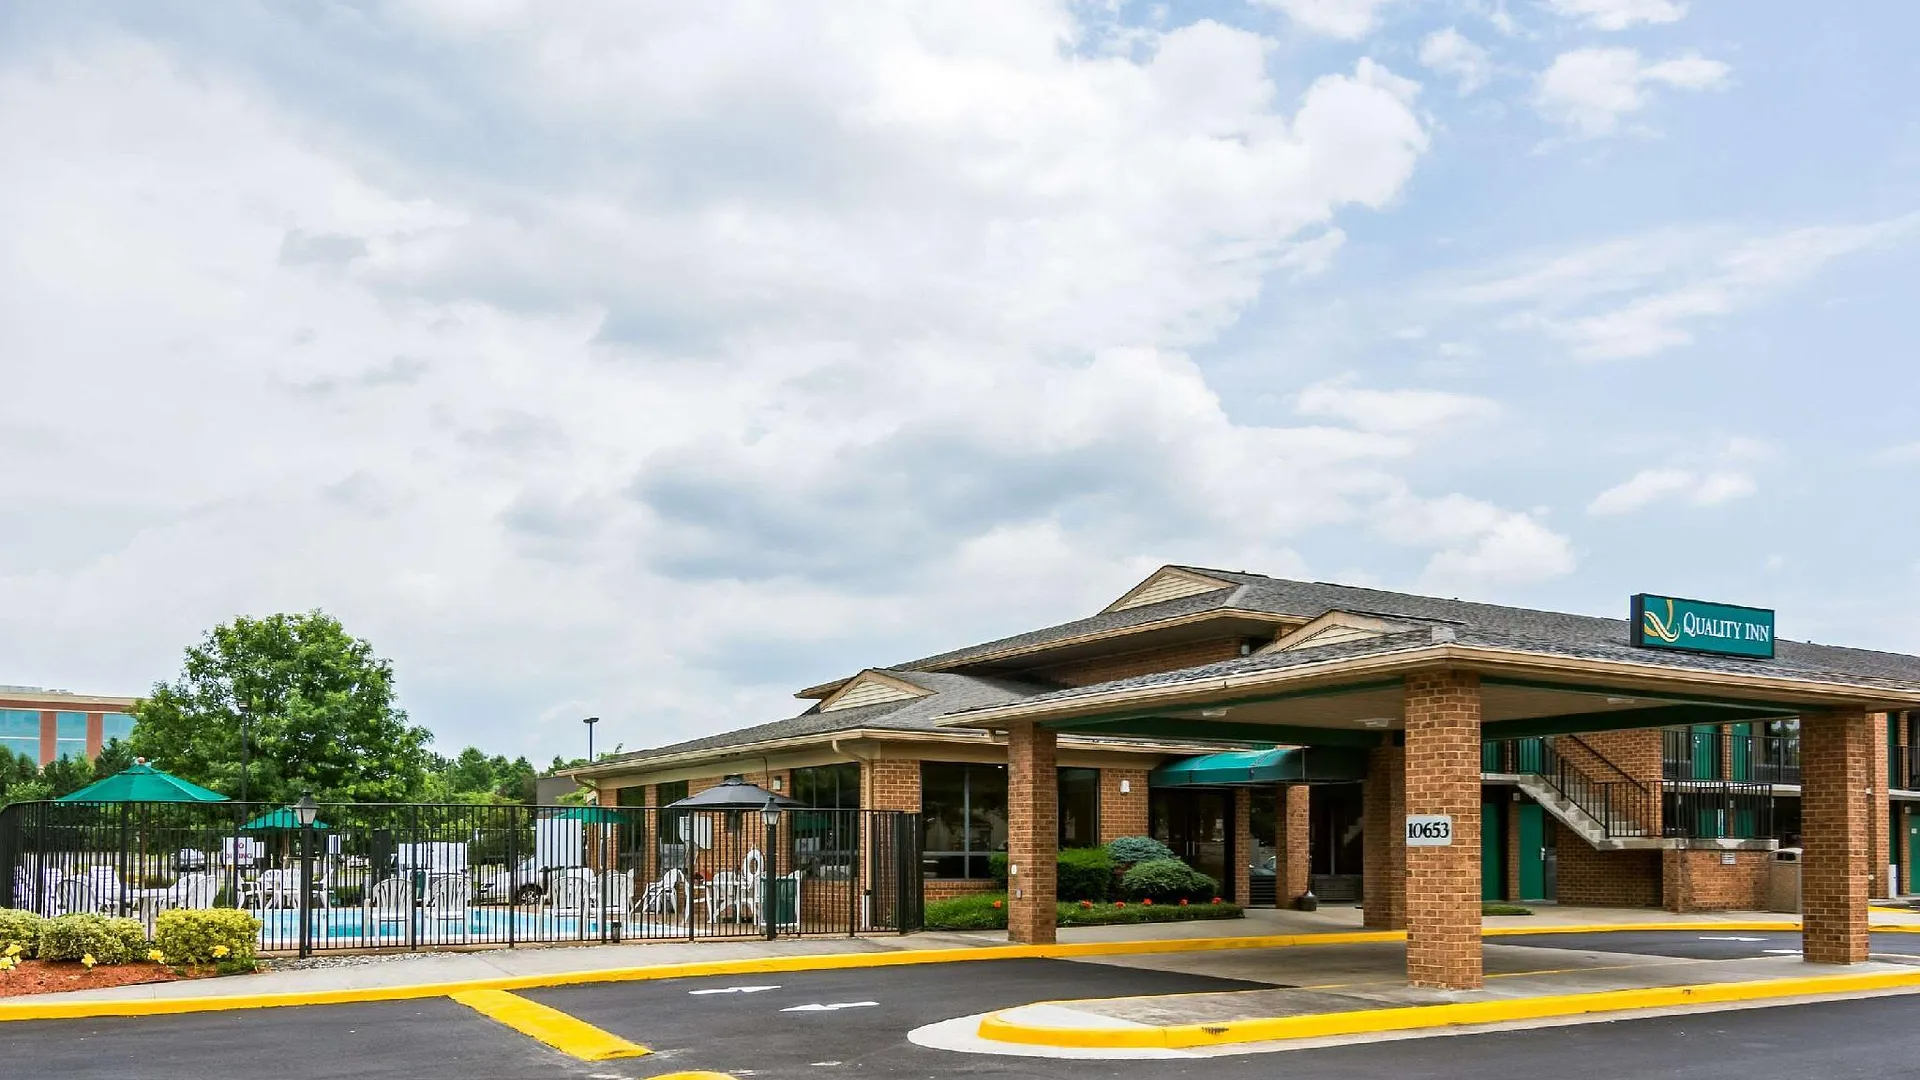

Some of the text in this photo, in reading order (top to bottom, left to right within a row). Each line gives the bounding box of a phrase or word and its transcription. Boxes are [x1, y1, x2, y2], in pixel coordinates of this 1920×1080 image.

[1683, 611, 1770, 642] QUALITY INN
[1407, 821, 1450, 839] 10653
